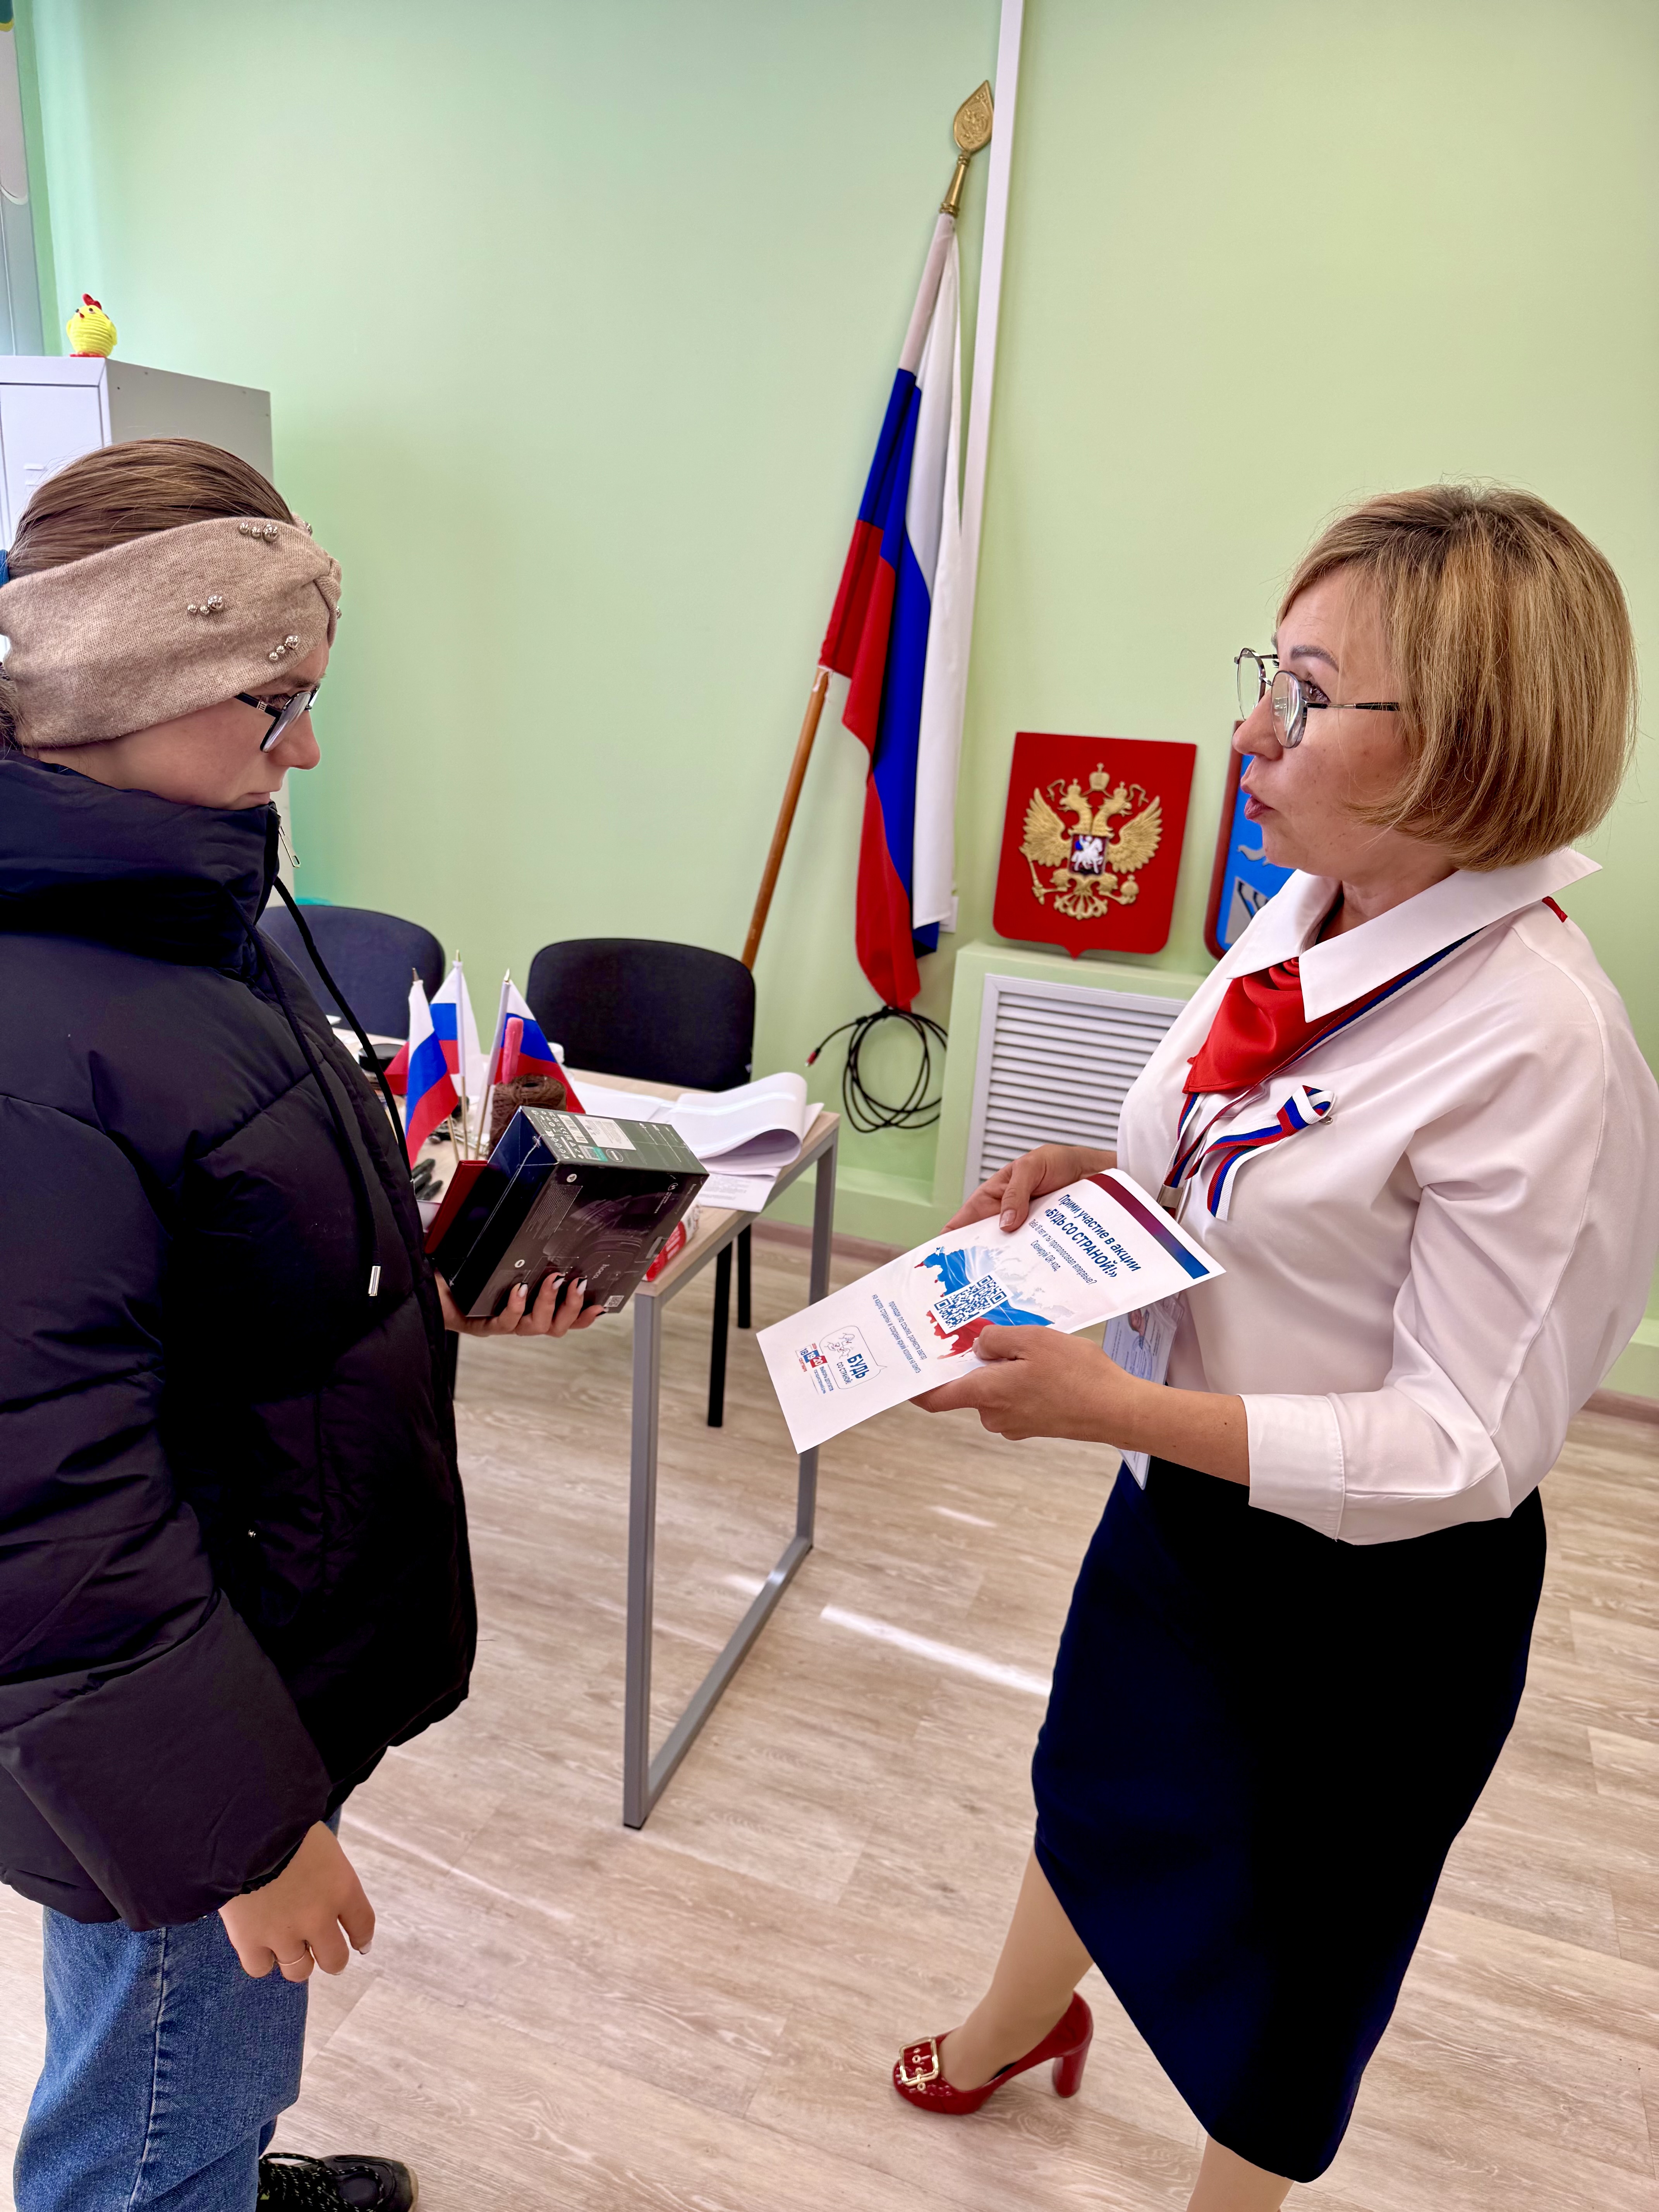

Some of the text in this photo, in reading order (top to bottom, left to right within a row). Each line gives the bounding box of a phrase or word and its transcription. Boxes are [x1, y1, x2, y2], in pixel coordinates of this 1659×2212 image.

[1045, 1209, 1117, 1277] «БУДЬ СО СТРАНОЙ!»
[1058, 1194, 1081, 1213] Прими
[1074, 1211, 1109, 1238] участие
[1110, 1244, 1140, 1271] акции
[1030, 1240, 1050, 1257] Сканируй
[592, 1264, 610, 1279] hoco.
[1049, 1240, 1076, 1265] проголосовал
[1072, 1264, 1097, 1284] впервые?
[880, 1309, 891, 1323] страны
[806, 1352, 816, 1360] 19
[813, 1356, 824, 1366] 20
[847, 1353, 869, 1378] БУДЬ
